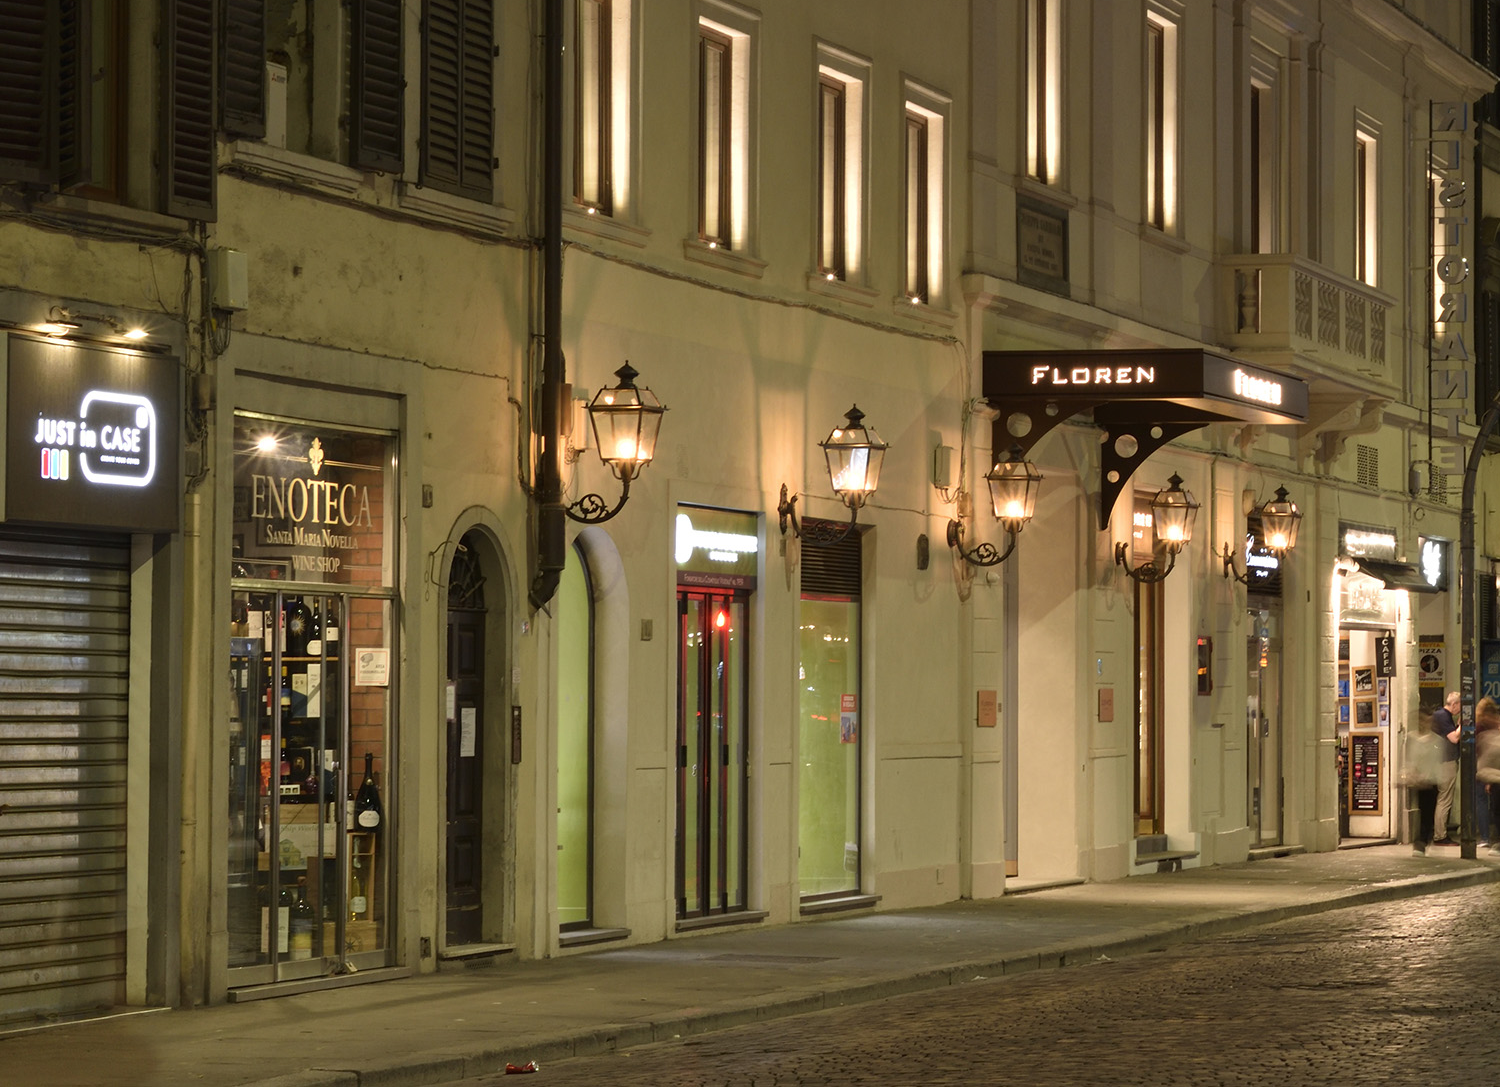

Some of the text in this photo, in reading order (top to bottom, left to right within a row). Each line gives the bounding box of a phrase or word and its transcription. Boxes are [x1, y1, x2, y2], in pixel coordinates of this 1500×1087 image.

[1031, 365, 1154, 384] FLOREN
[34, 417, 141, 453] JUST in CASE
[251, 474, 373, 528] ENOTECA
[266, 524, 358, 550] SANTA MARIA NOVELLA
[291, 554, 340, 573] WINE SHOP
